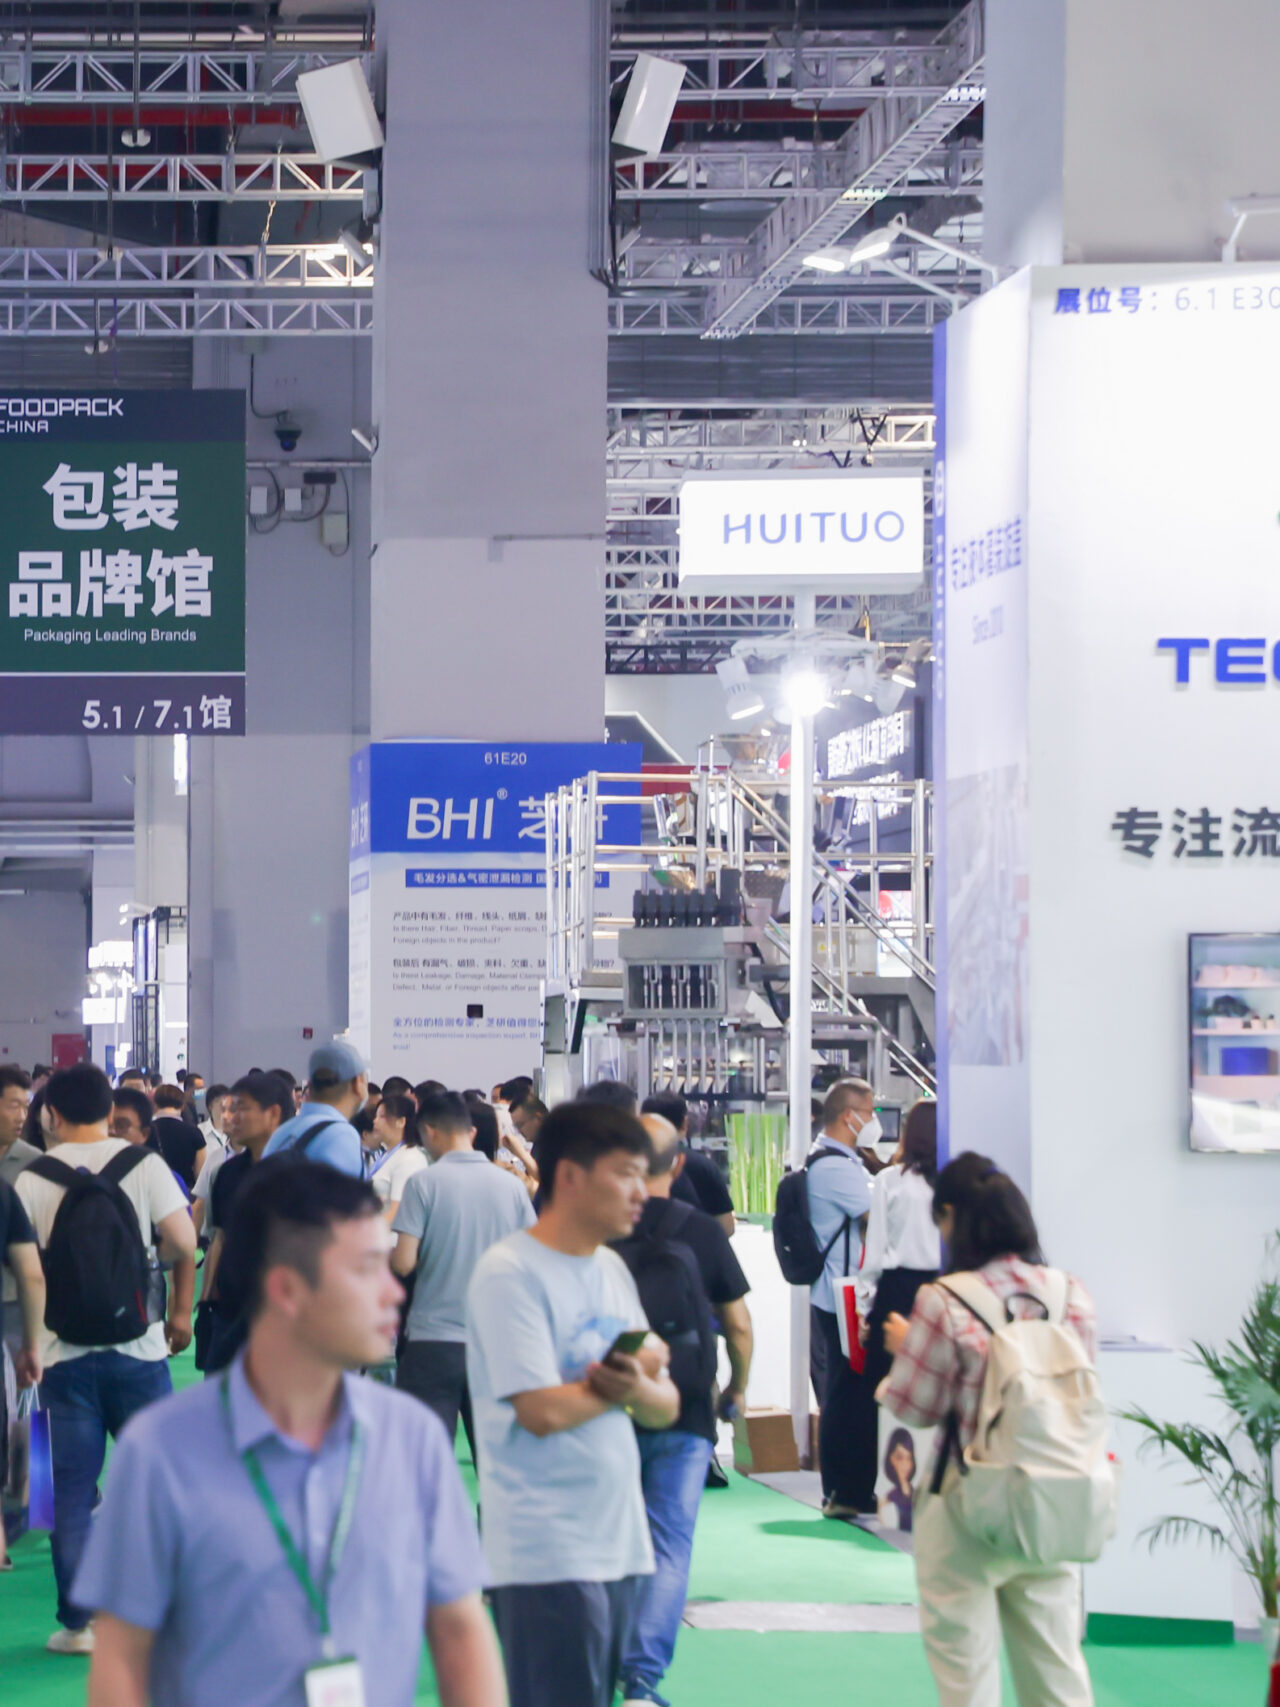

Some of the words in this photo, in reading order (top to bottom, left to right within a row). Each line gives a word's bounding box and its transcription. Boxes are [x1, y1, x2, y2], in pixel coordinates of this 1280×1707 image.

[42, 461, 179, 533] 包装
[723, 510, 905, 545] HUITUO
[9, 548, 214, 618] 品牌馆
[24, 628, 91, 644] Packaging
[95, 628, 147, 644] Leading
[151, 628, 197, 642] Brands
[1157, 638, 1280, 683] TE
[484, 752, 527, 766] 61E20
